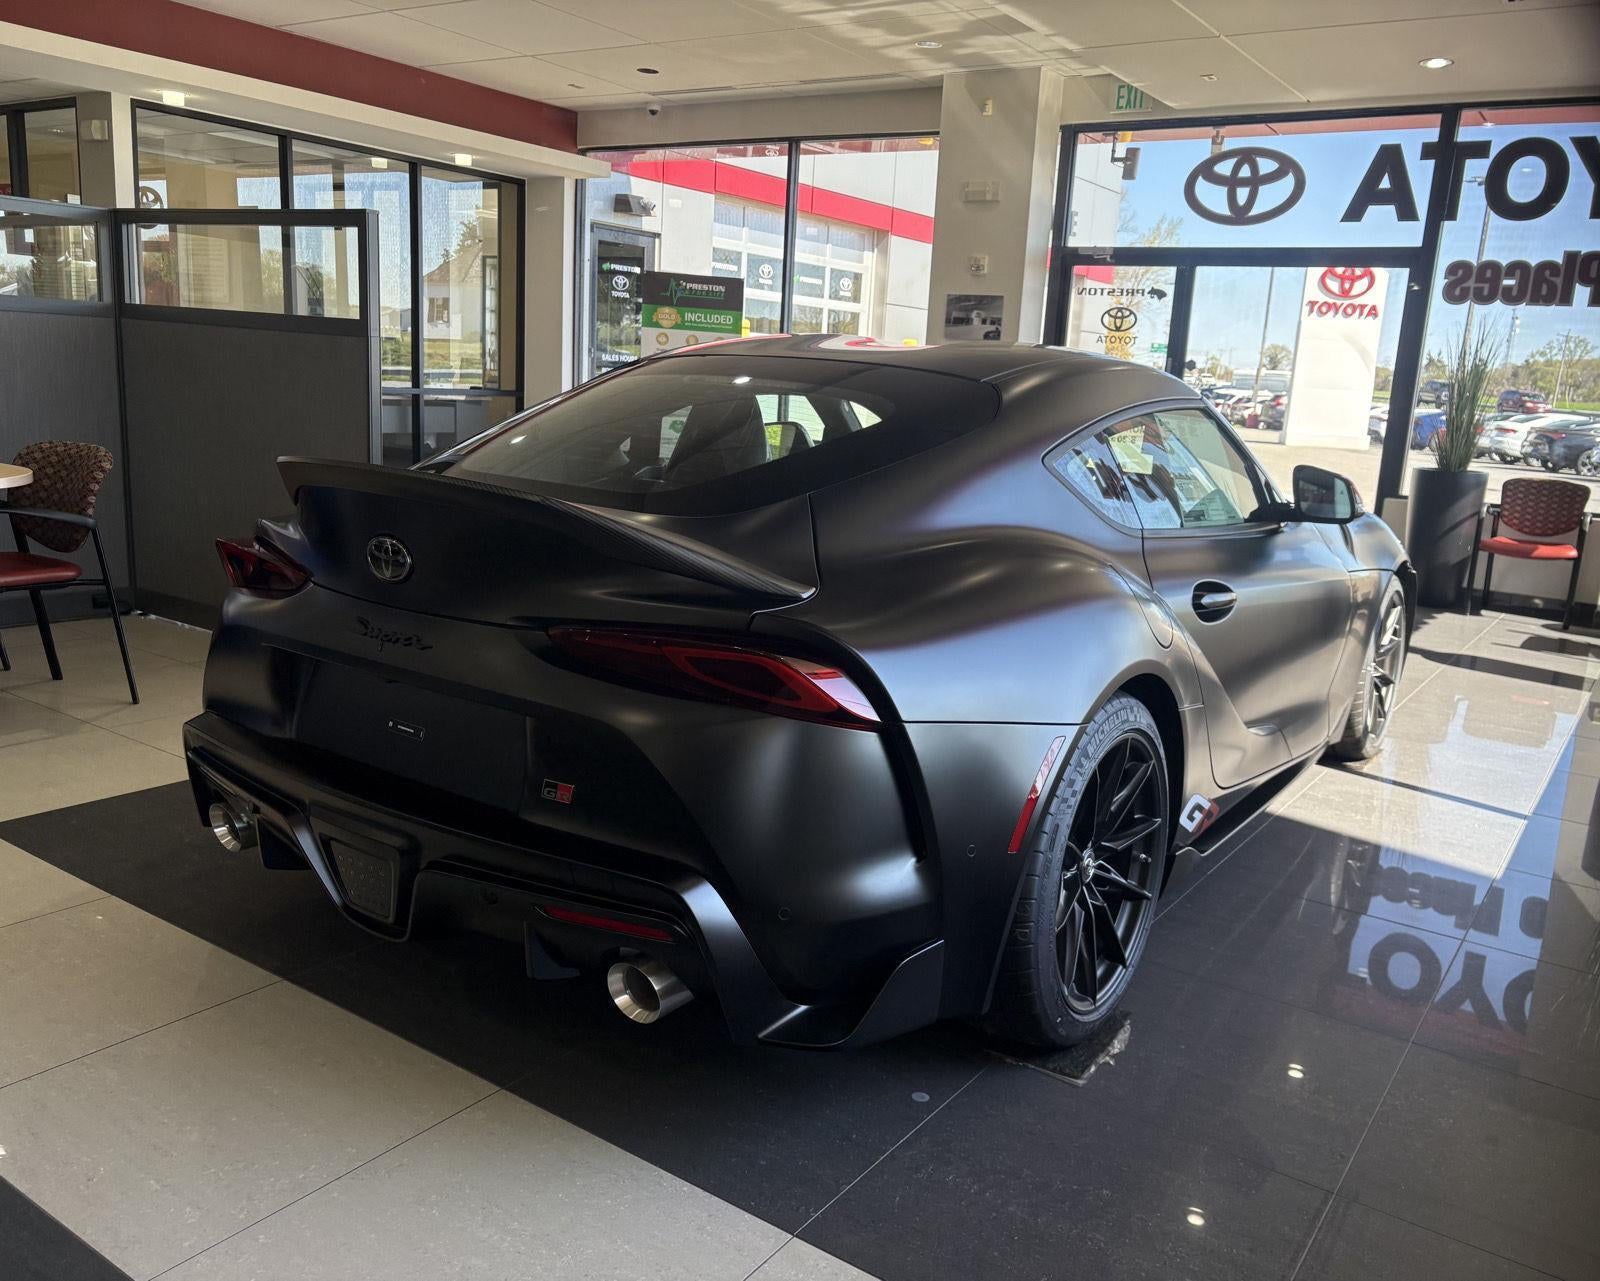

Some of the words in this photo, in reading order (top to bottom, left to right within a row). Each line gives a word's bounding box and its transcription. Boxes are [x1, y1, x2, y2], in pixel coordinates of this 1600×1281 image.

[1116, 84, 1144, 109] EXIT
[610, 263, 640, 274] PRESTON
[687, 282, 726, 292] PRESTON
[658, 313, 676, 321] GOLD
[1306, 300, 1379, 319] TOYOTA
[684, 312, 734, 325] INCLUDED
[357, 615, 434, 652] Supra
[1086, 707, 1128, 758] MICHELIN
